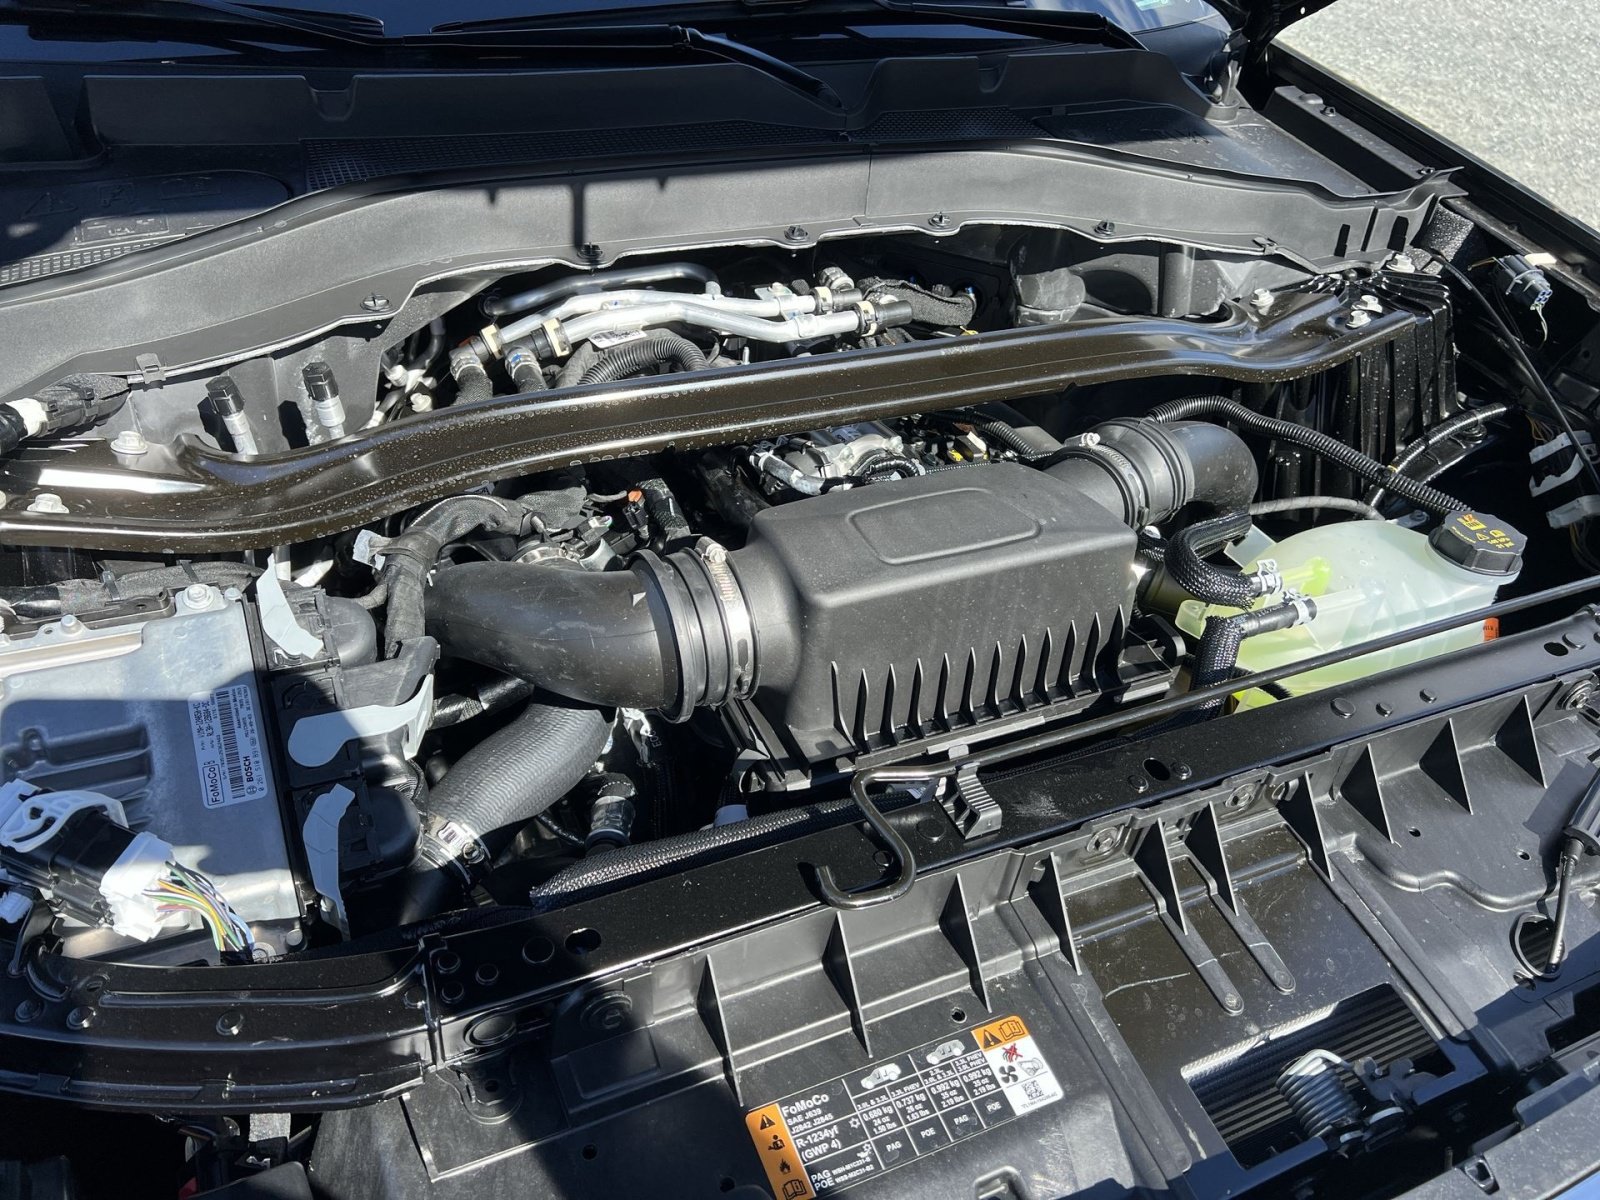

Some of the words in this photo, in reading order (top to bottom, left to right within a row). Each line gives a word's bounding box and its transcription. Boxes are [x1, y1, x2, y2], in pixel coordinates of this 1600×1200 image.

[243, 756, 254, 782] BOSCH
[208, 767, 220, 803] FoMoCo
[962, 1070, 981, 1083] 0.992
[981, 1068, 991, 1076] kg
[931, 1082, 951, 1095] 0.992
[951, 1079, 960, 1088] kg
[973, 1080, 981, 1088] 35
[973, 1087, 986, 1096] 2.19
[986, 1083, 996, 1092] lbs
[781, 1094, 830, 1117] FoMoCo
[896, 1095, 915, 1108] 0.737
[915, 1092, 926, 1102] kg
[941, 1099, 954, 1108] 2.19
[954, 1095, 964, 1104] lbs
[987, 1101, 1002, 1112] POE
[882, 1105, 893, 1114] kg
[919, 1109, 930, 1117] lbs
[787, 1115, 804, 1126] SAE
[805, 1108, 822, 1120] J639
[791, 1121, 812, 1134] J2842
[812, 1113, 834, 1126] J2845
[954, 1114, 969, 1125] PAG
[886, 1122, 897, 1130] lbs
[920, 1128, 936, 1138] POE
[795, 1125, 839, 1149] R-1234yf
[801, 1142, 829, 1162] (GWP
[831, 1138, 842, 1149] 4)
[886, 1141, 902, 1152] PAG
[811, 1169, 832, 1183] PAG
[814, 1177, 835, 1191] POE
